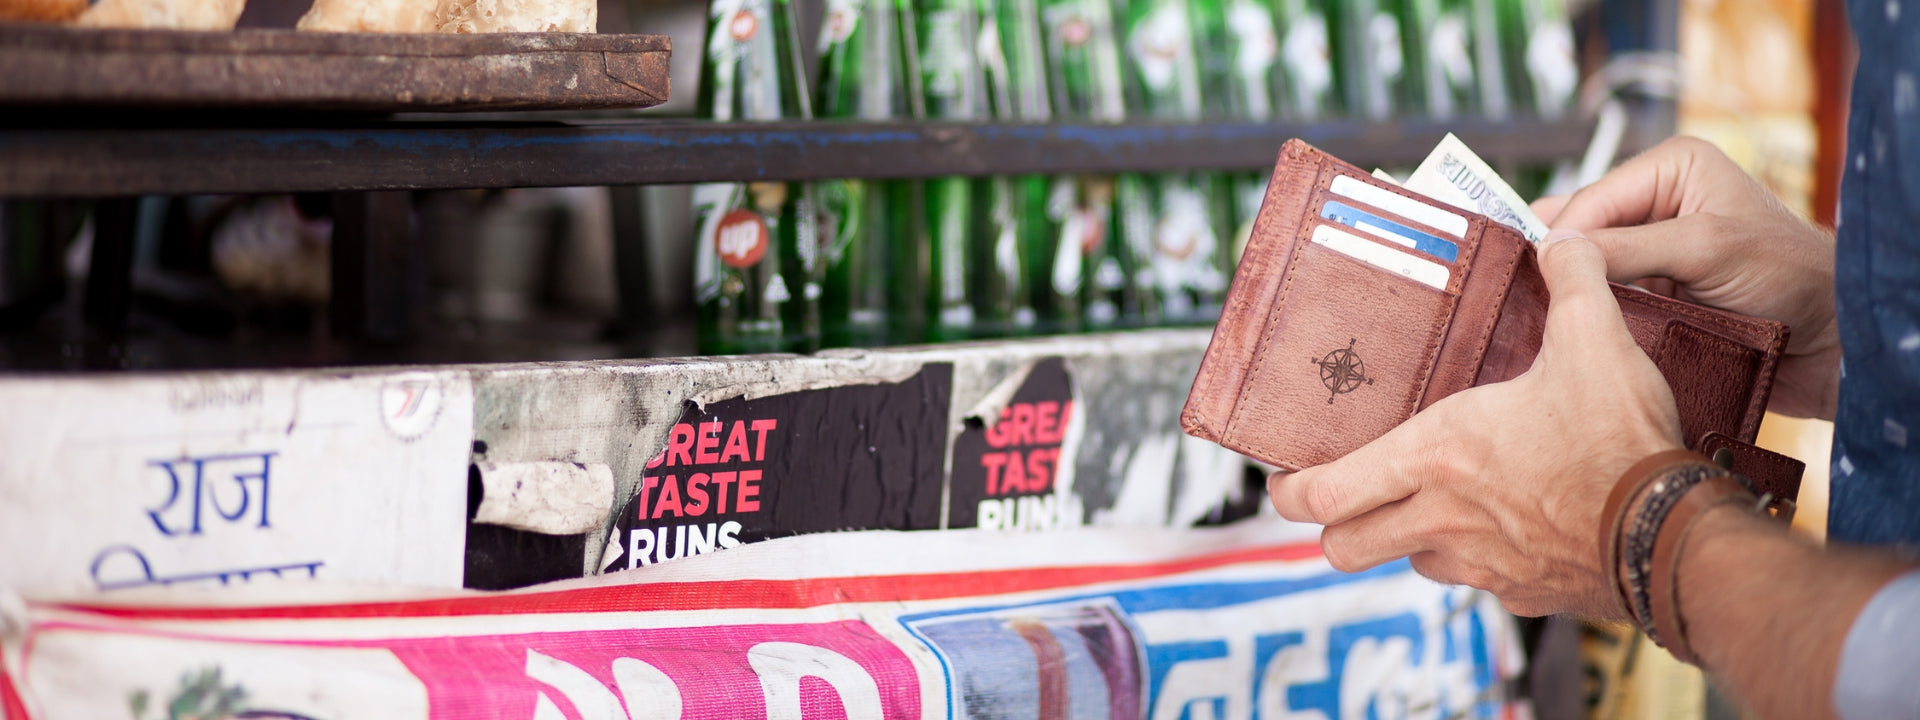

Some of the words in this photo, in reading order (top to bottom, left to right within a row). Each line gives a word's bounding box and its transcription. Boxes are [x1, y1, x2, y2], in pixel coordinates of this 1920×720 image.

[645, 419, 777, 469] REAT
[146, 451, 280, 536] राज
[638, 469, 763, 520] TASTE
[629, 520, 743, 570] RUNS
